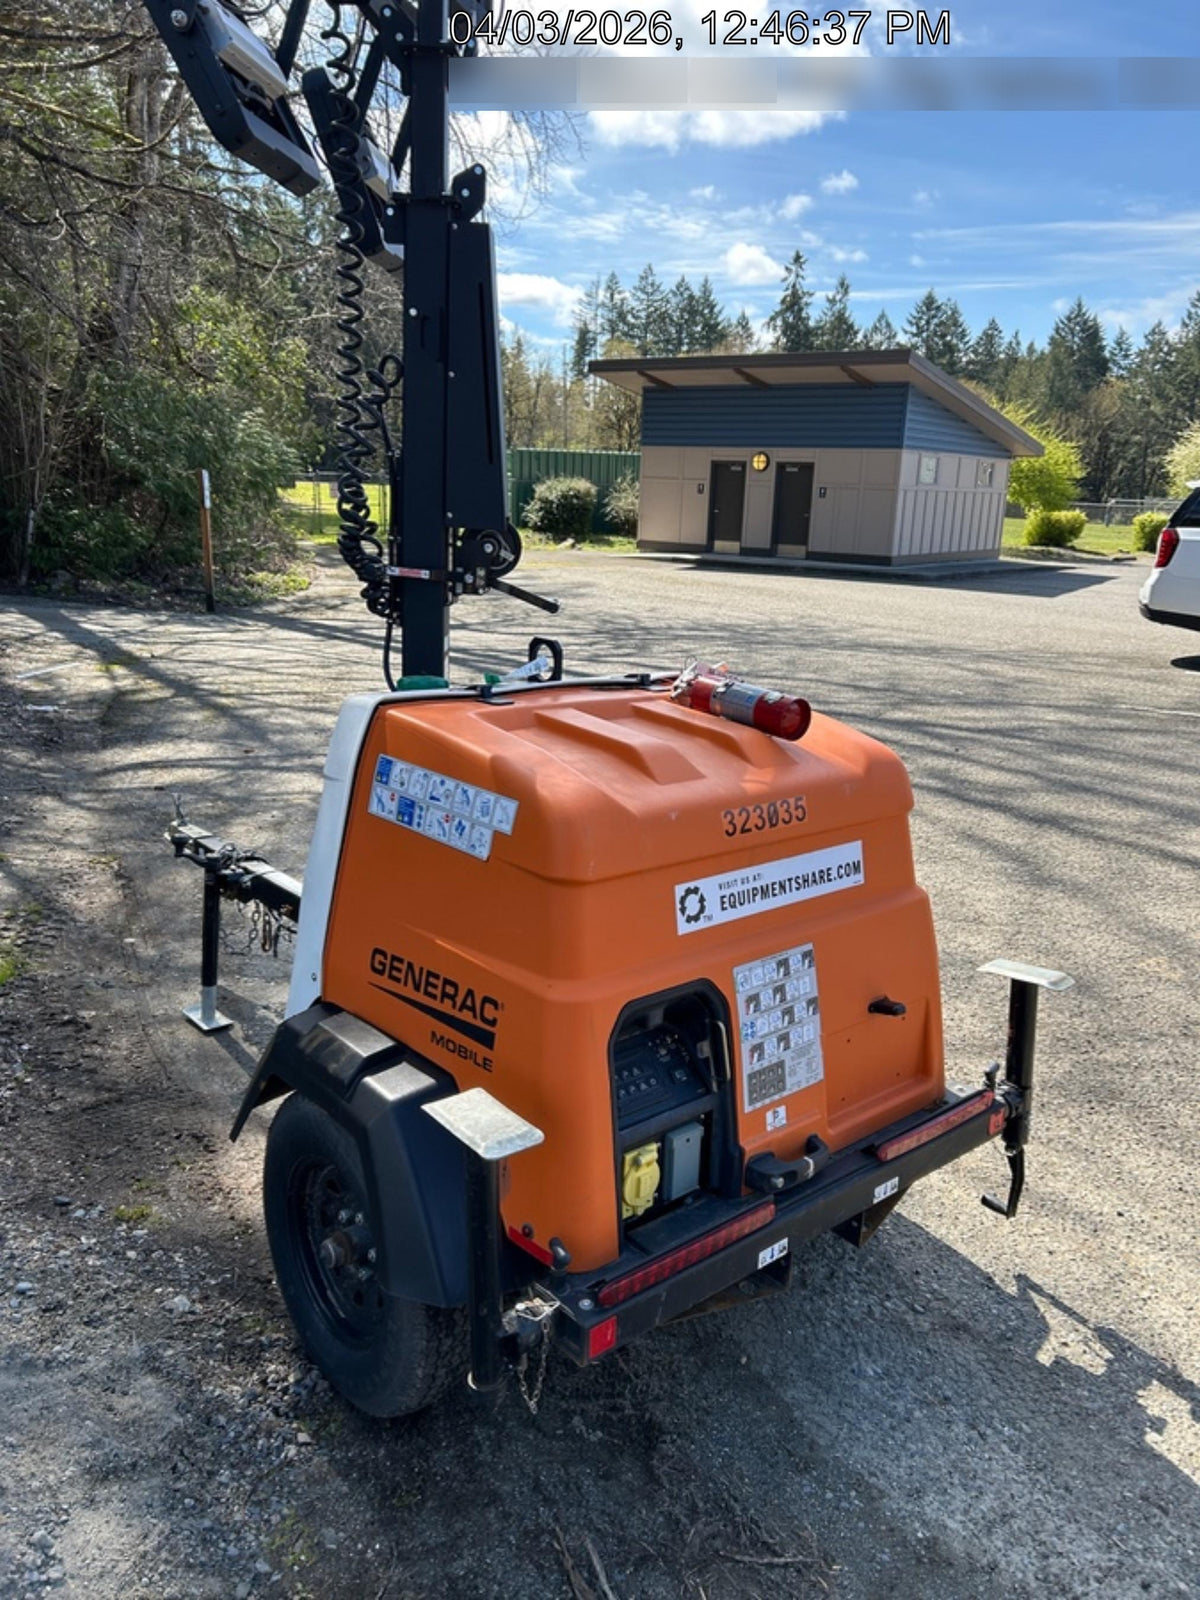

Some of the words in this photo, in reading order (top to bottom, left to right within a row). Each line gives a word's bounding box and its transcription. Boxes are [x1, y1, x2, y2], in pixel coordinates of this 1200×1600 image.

[722, 796, 807, 837] 323035
[718, 879, 738, 891] VISIT
[740, 876, 751, 886] US
[720, 860, 861, 911] EQUIPMENTSHARE.COM
[369, 947, 500, 1028] GENERAC
[430, 1030, 494, 1073] MOBILE
